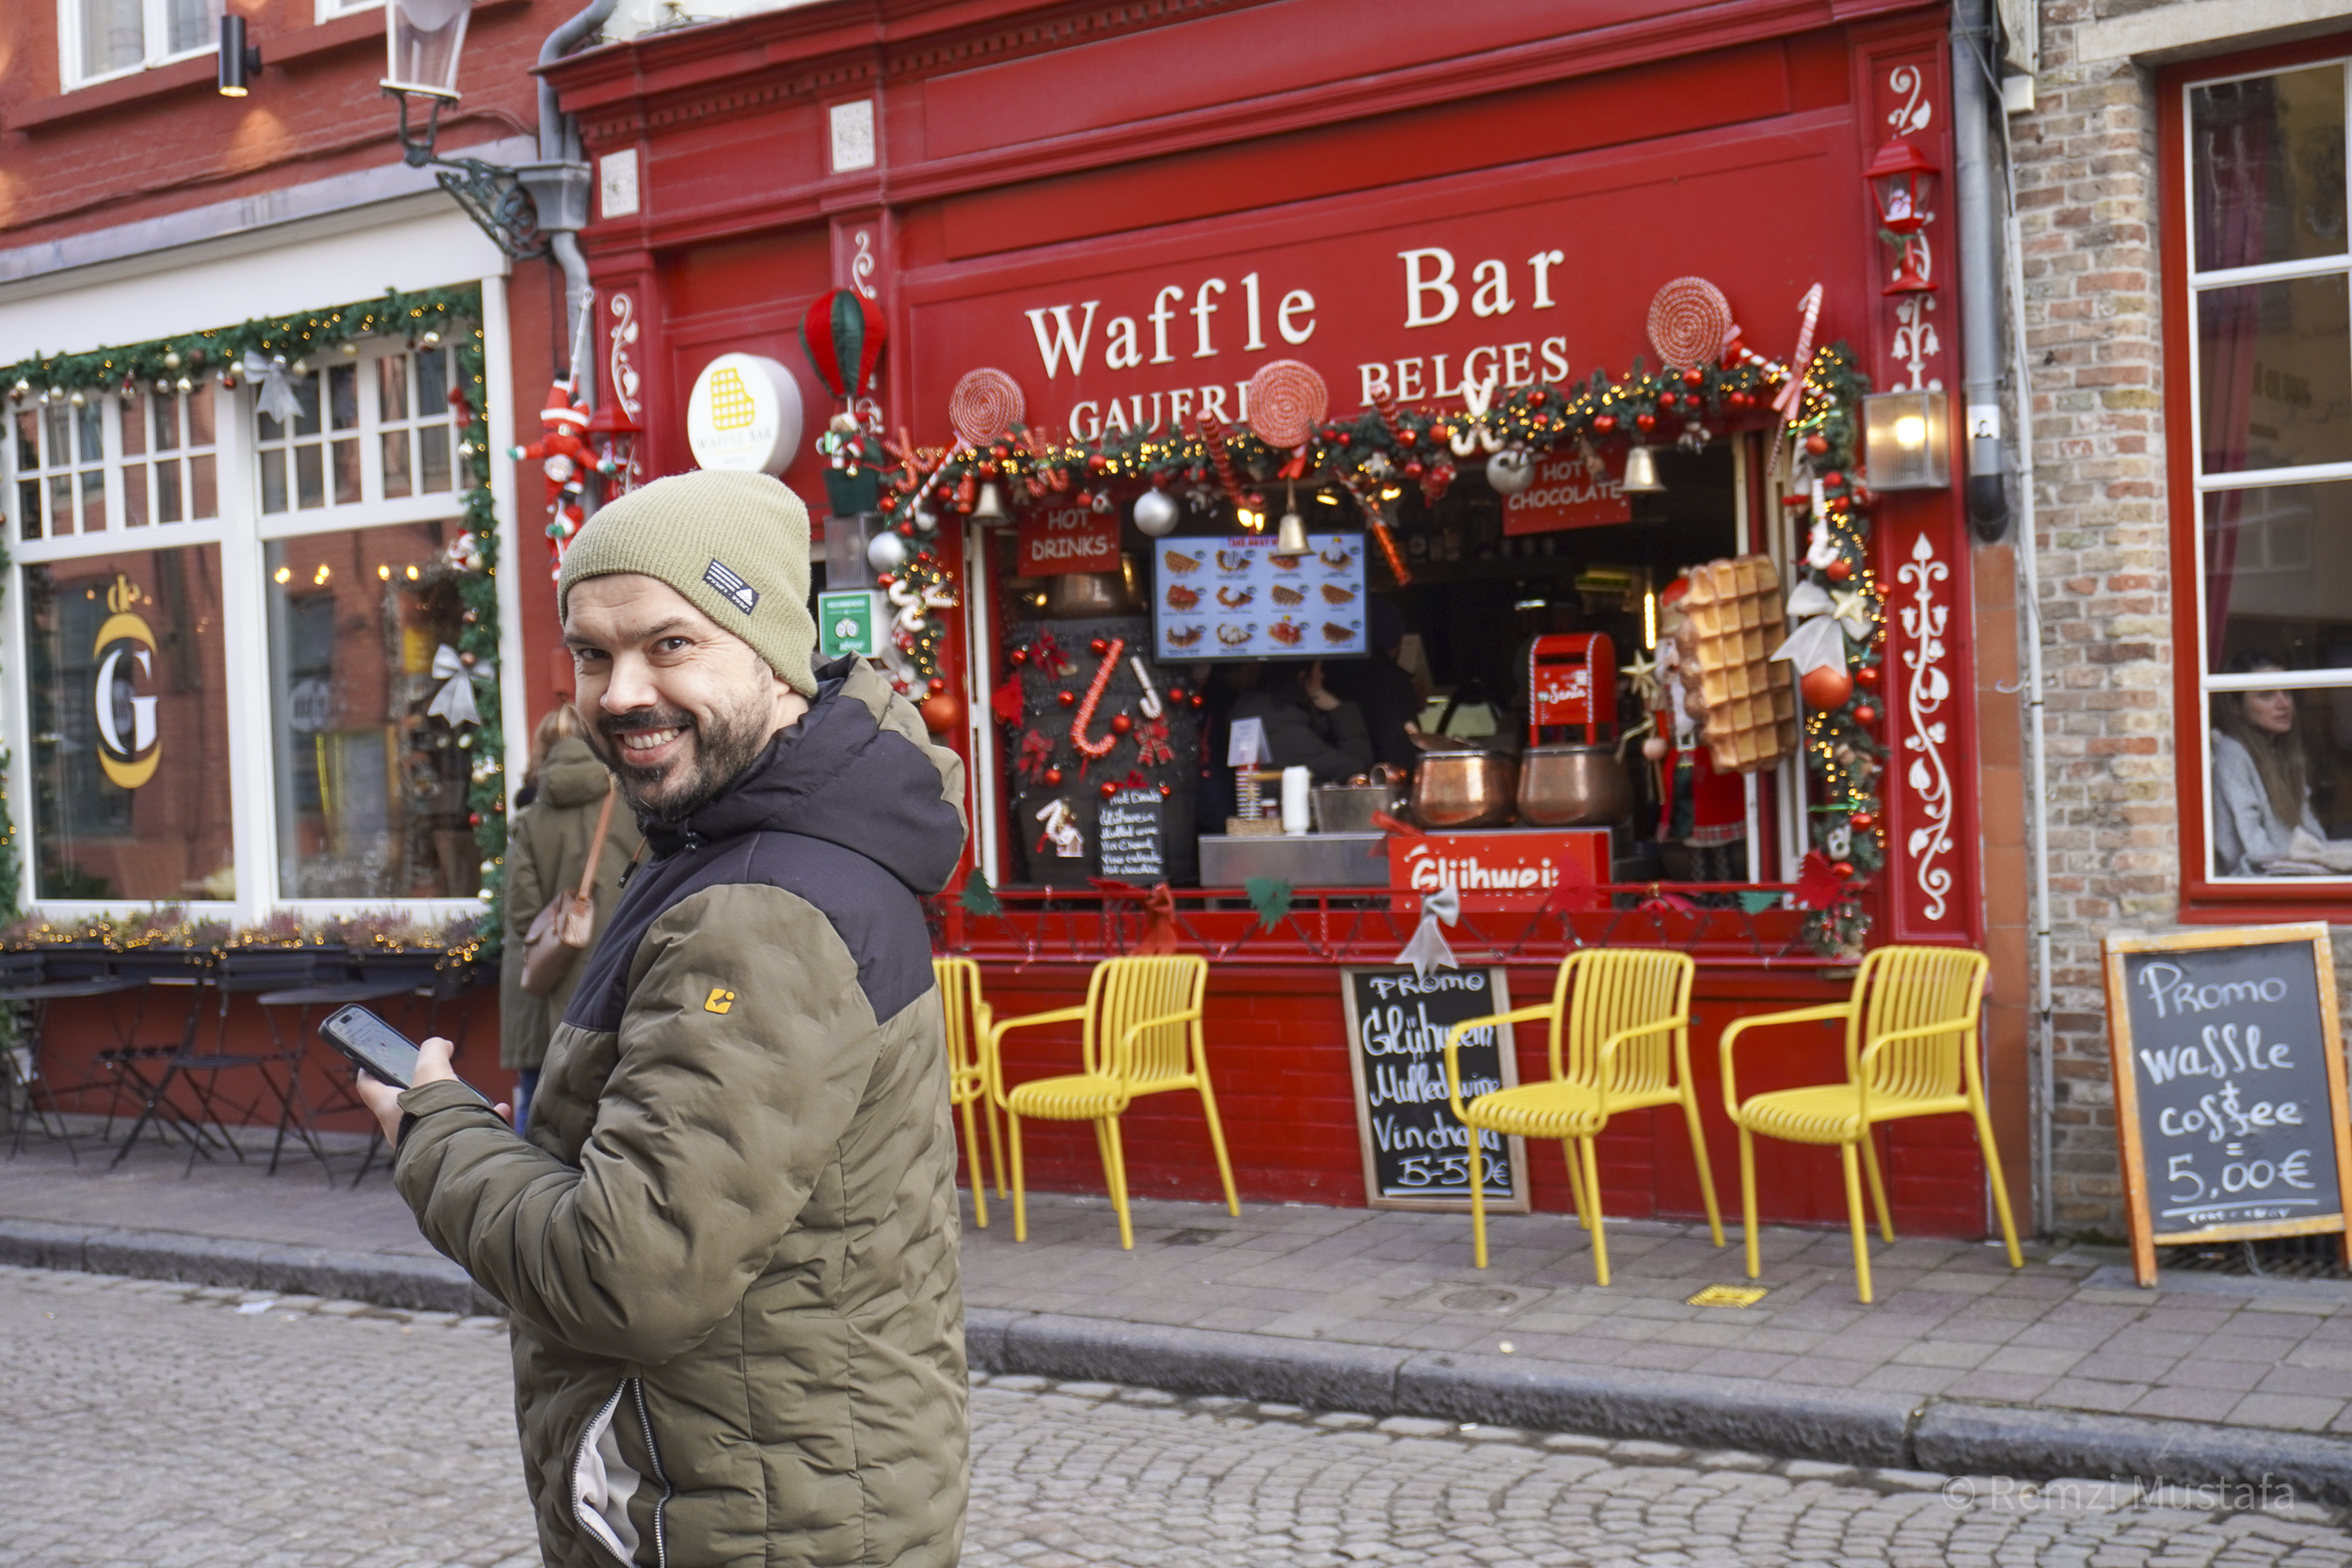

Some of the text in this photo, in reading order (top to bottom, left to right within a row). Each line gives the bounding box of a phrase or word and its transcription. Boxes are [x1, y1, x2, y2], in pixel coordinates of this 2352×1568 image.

[1025, 246, 1565, 379] Waffle Bar
[1357, 336, 1569, 406] BELGES
[696, 427, 771, 450] WAFFLE BAR
[1543, 460, 1582, 481] HOT
[1508, 479, 1623, 511] CHOCOLATE
[1047, 509, 1090, 531] HOT
[1031, 535, 1108, 561] DRINKS
[96, 649, 159, 754] G
[1549, 682, 1587, 705] Santa
[1411, 856, 1559, 894] Glühwei
[1370, 1061, 1451, 1108] Mulled
